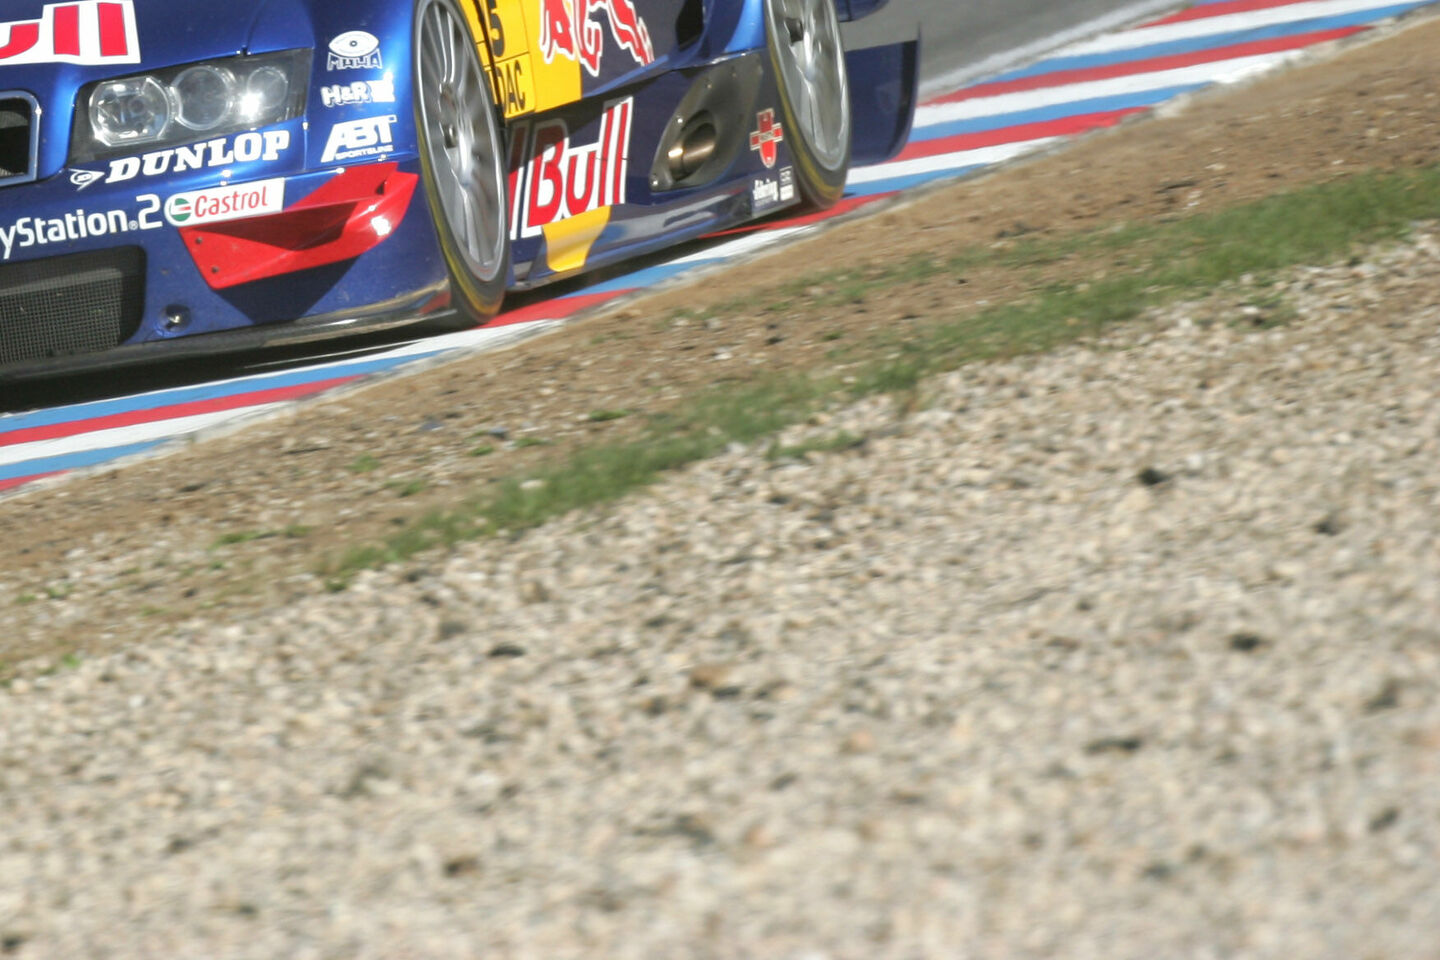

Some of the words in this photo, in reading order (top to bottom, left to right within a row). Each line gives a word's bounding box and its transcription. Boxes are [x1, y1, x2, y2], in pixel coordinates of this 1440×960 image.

[488, 60, 526, 115] DAC
[105, 130, 290, 183] DUNLOP
[321, 114, 397, 163] ABT
[521, 97, 633, 238] Bull
[194, 186, 268, 218] Castrol
